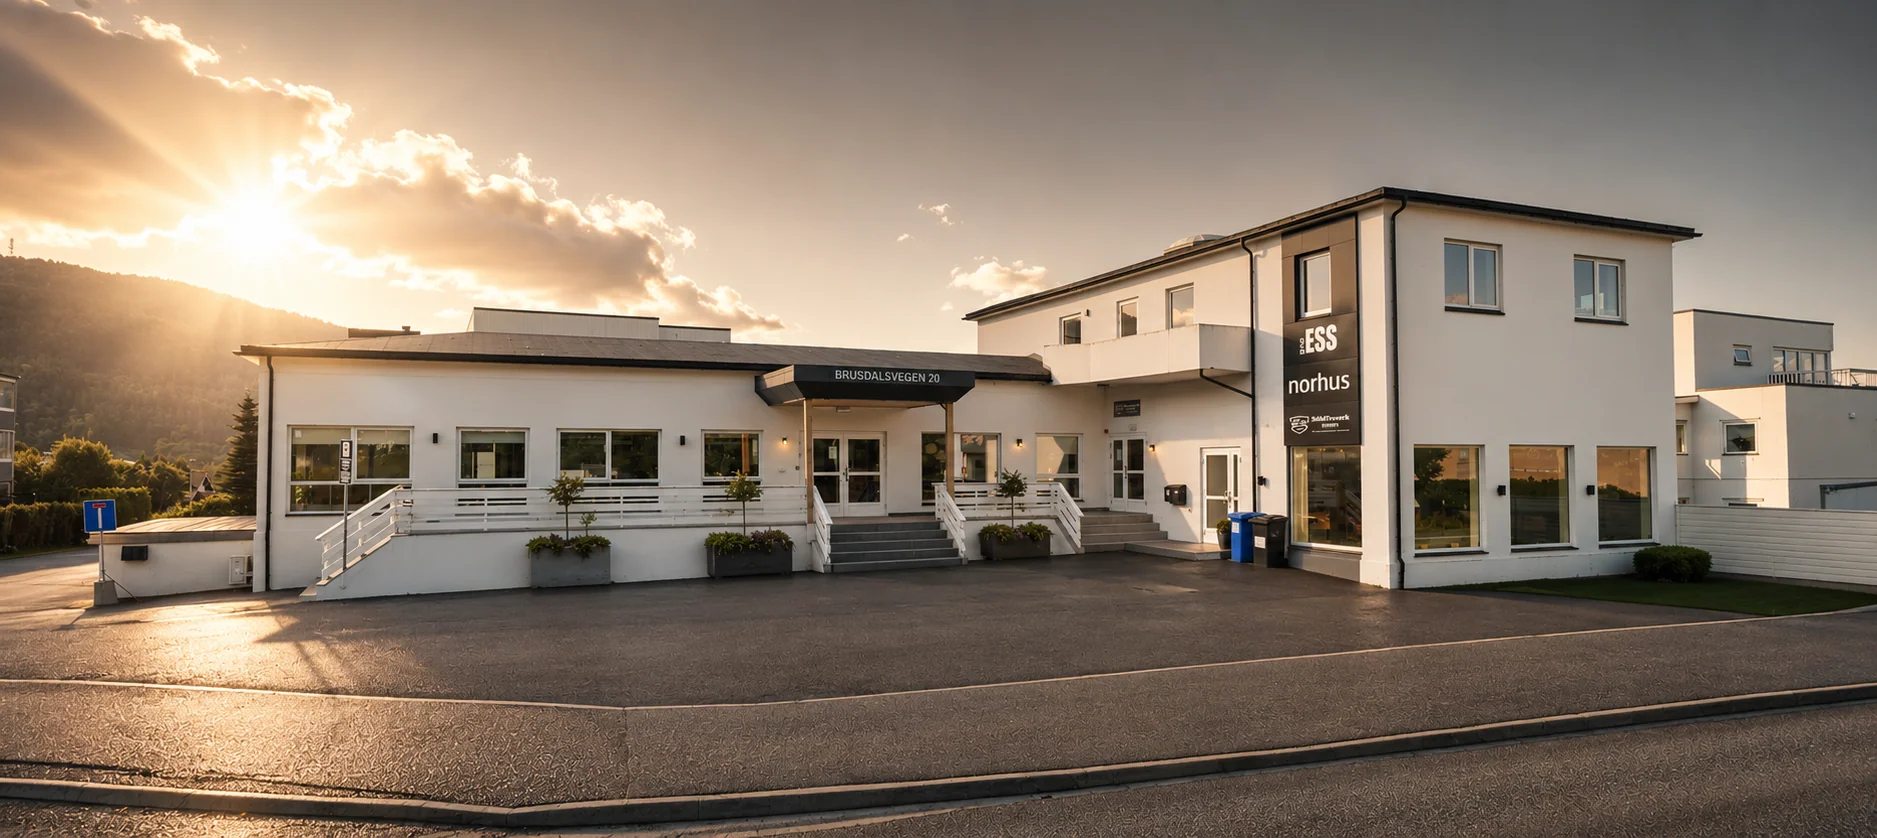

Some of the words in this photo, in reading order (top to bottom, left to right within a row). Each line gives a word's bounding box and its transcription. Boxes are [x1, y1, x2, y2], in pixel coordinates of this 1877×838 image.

[1305, 324, 1337, 354] ESS
[835, 369, 926, 383] BRUSDALSVEGEN
[928, 373, 940, 383] 20
[1288, 372, 1350, 394] norhus
